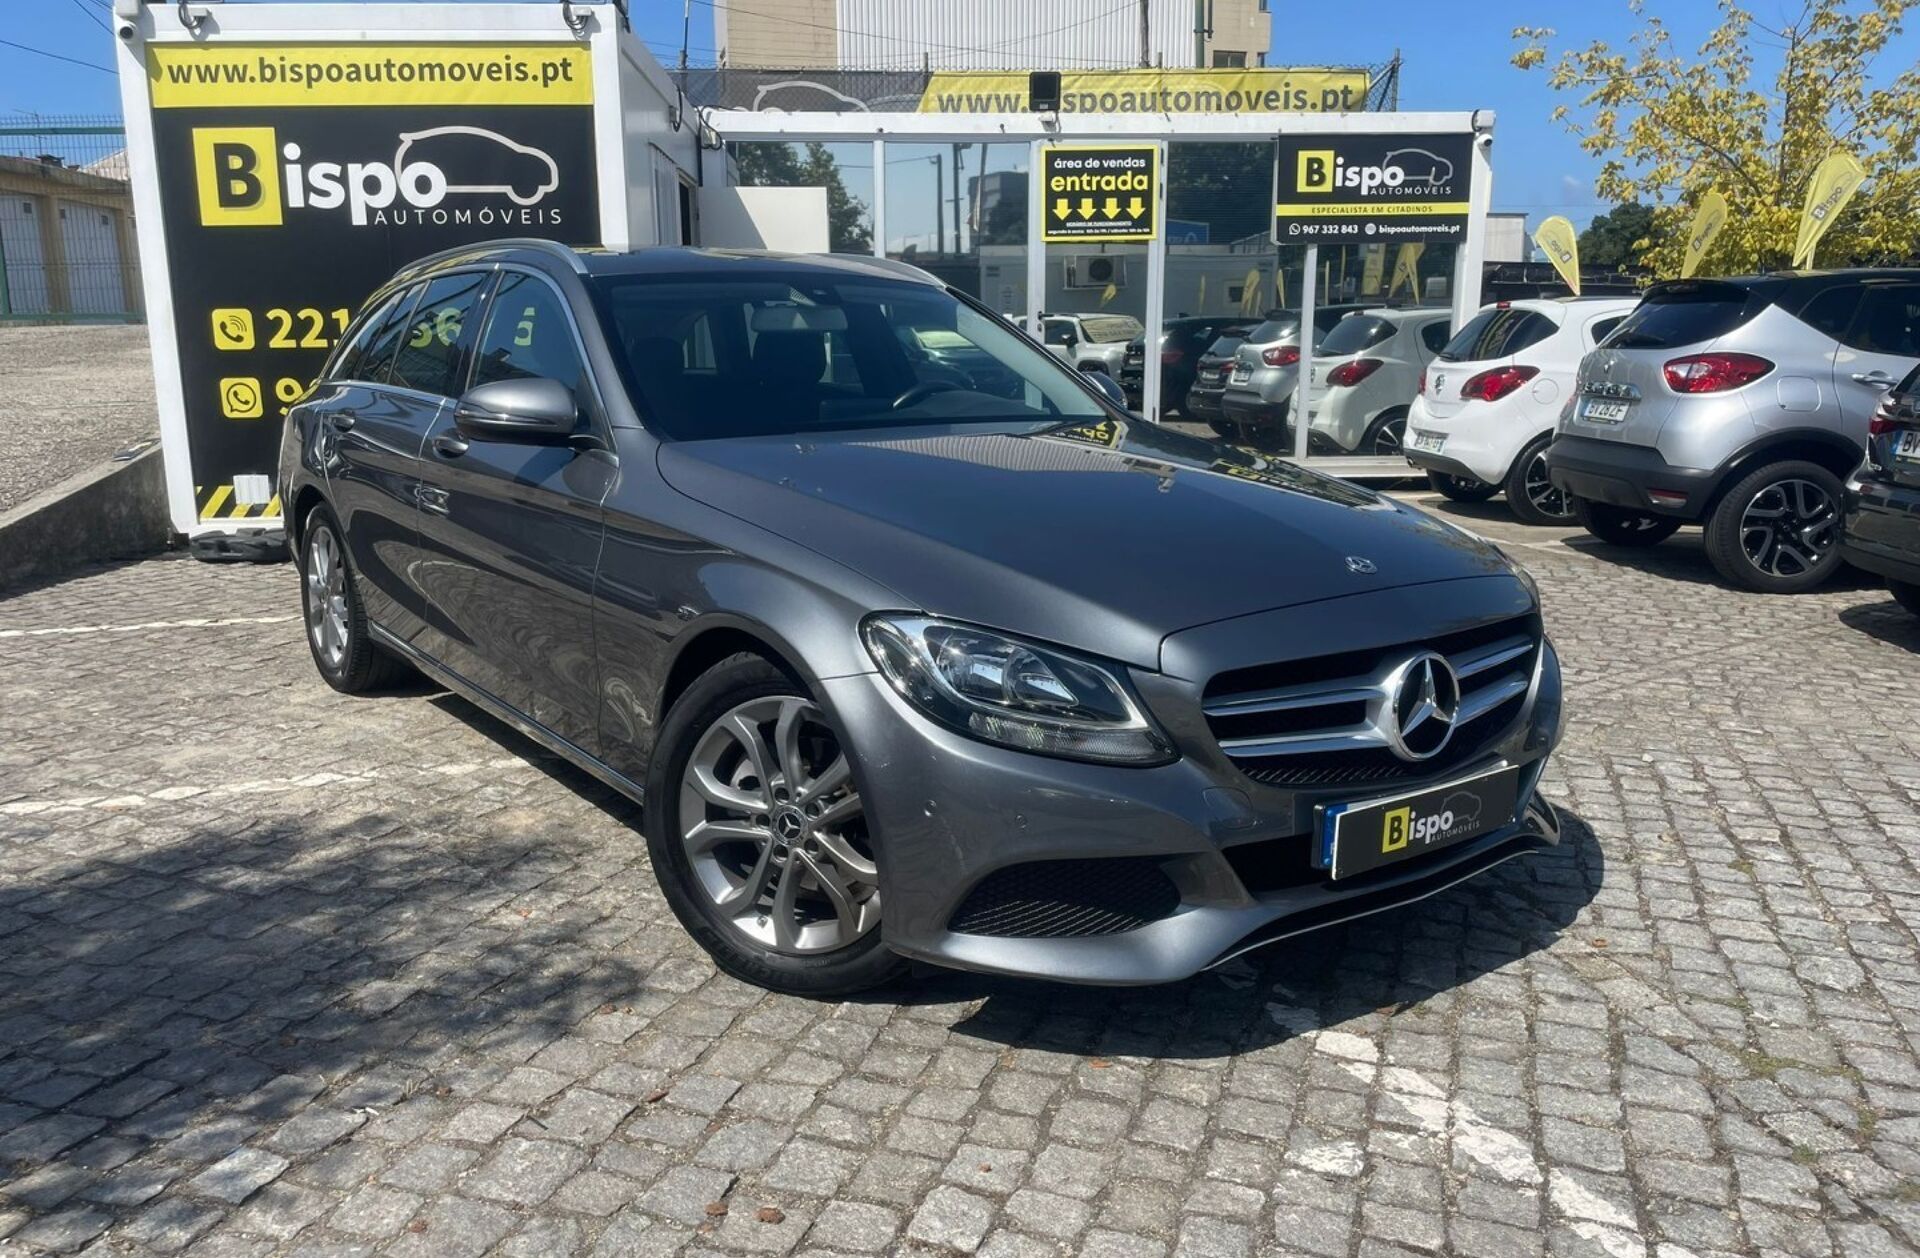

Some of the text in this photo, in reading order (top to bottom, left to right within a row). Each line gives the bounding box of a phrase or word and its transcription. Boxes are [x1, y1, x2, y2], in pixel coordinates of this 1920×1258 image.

[167, 53, 573, 89] www.bispoautomoveis.pt
[937, 82, 1353, 113] www.spoautomoveis.pt
[1054, 157, 1146, 168] área de vendas
[213, 142, 447, 226] Bispo
[1050, 170, 1149, 191] entrada
[1305, 156, 1405, 195] Bispo
[1370, 185, 1452, 195] AUTOMÓVEIS
[375, 206, 562, 225] AUTOMÓVEIS
[1311, 206, 1368, 214] ESPECIALISTA
[1387, 205, 1433, 213] CITADINOS
[1302, 223, 1460, 236] 967 332 843 bispoautomoveis.pt
[1388, 809, 1454, 846] Bispo
